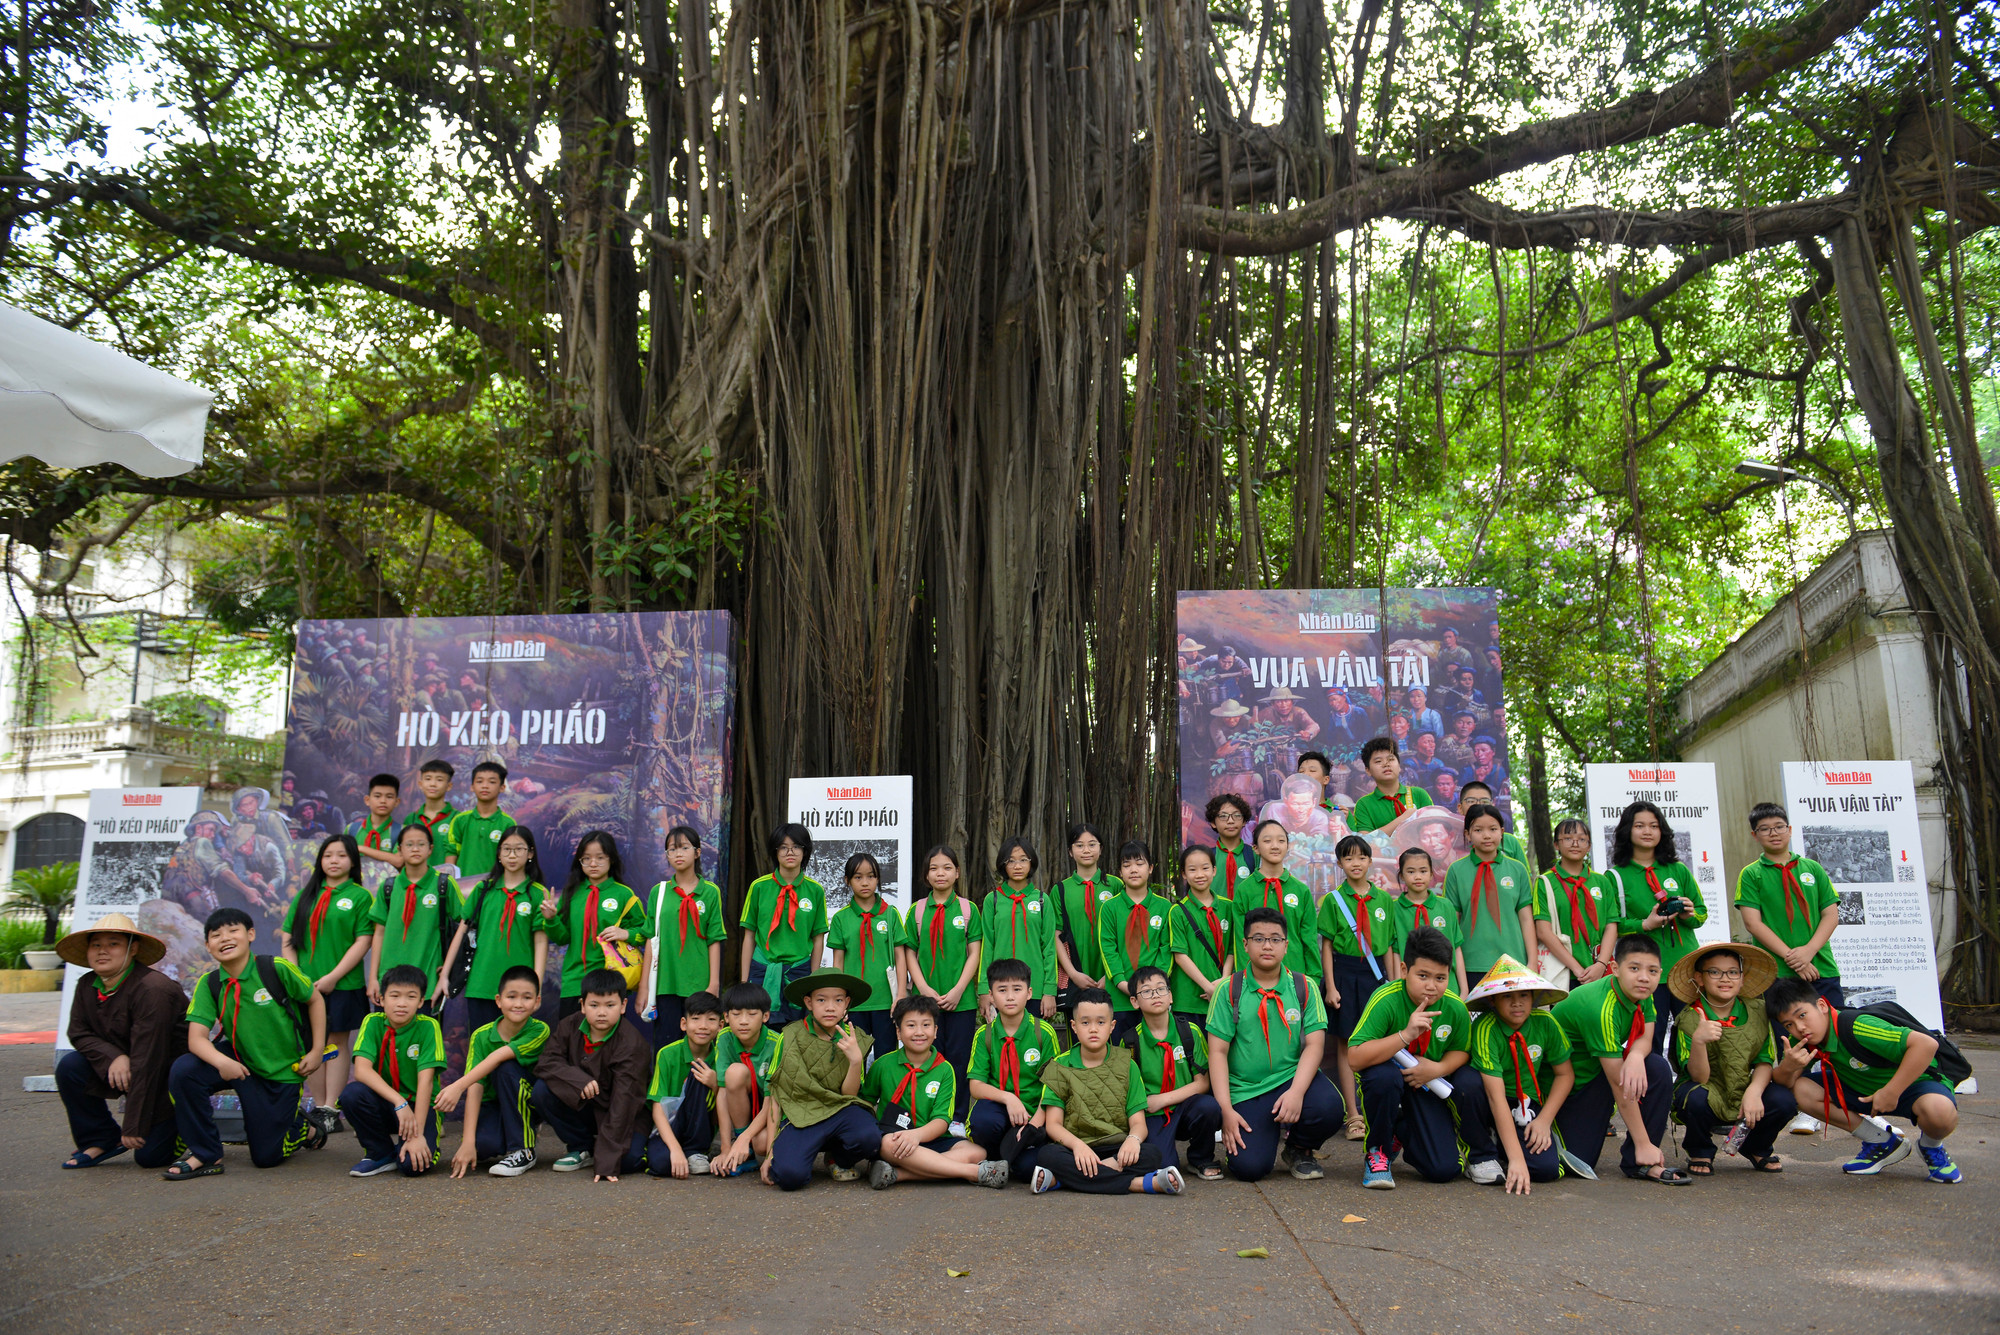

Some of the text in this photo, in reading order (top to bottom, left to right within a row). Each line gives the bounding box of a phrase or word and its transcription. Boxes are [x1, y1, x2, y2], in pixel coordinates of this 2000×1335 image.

[1299, 613, 1375, 629] Nhân Dân
[469, 640, 546, 658] Nhân Dân
[1249, 657, 1309, 688] VUA
[1316, 650, 1378, 692] VẬN
[397, 702, 606, 747] HÒ KÉO PHÁO
[1629, 769, 1676, 780] Nhân Dân
[1825, 772, 1872, 782] Nhân Dân
[122, 794, 162, 803] Nhân Dân
[827, 786, 871, 798] Nhân Dân
[1664, 790, 1678, 802] OF
[1840, 794, 1870, 815] VẬN
[801, 806, 898, 827] HÒ KÉO PHÁO
[119, 817, 142, 834] KÉO
